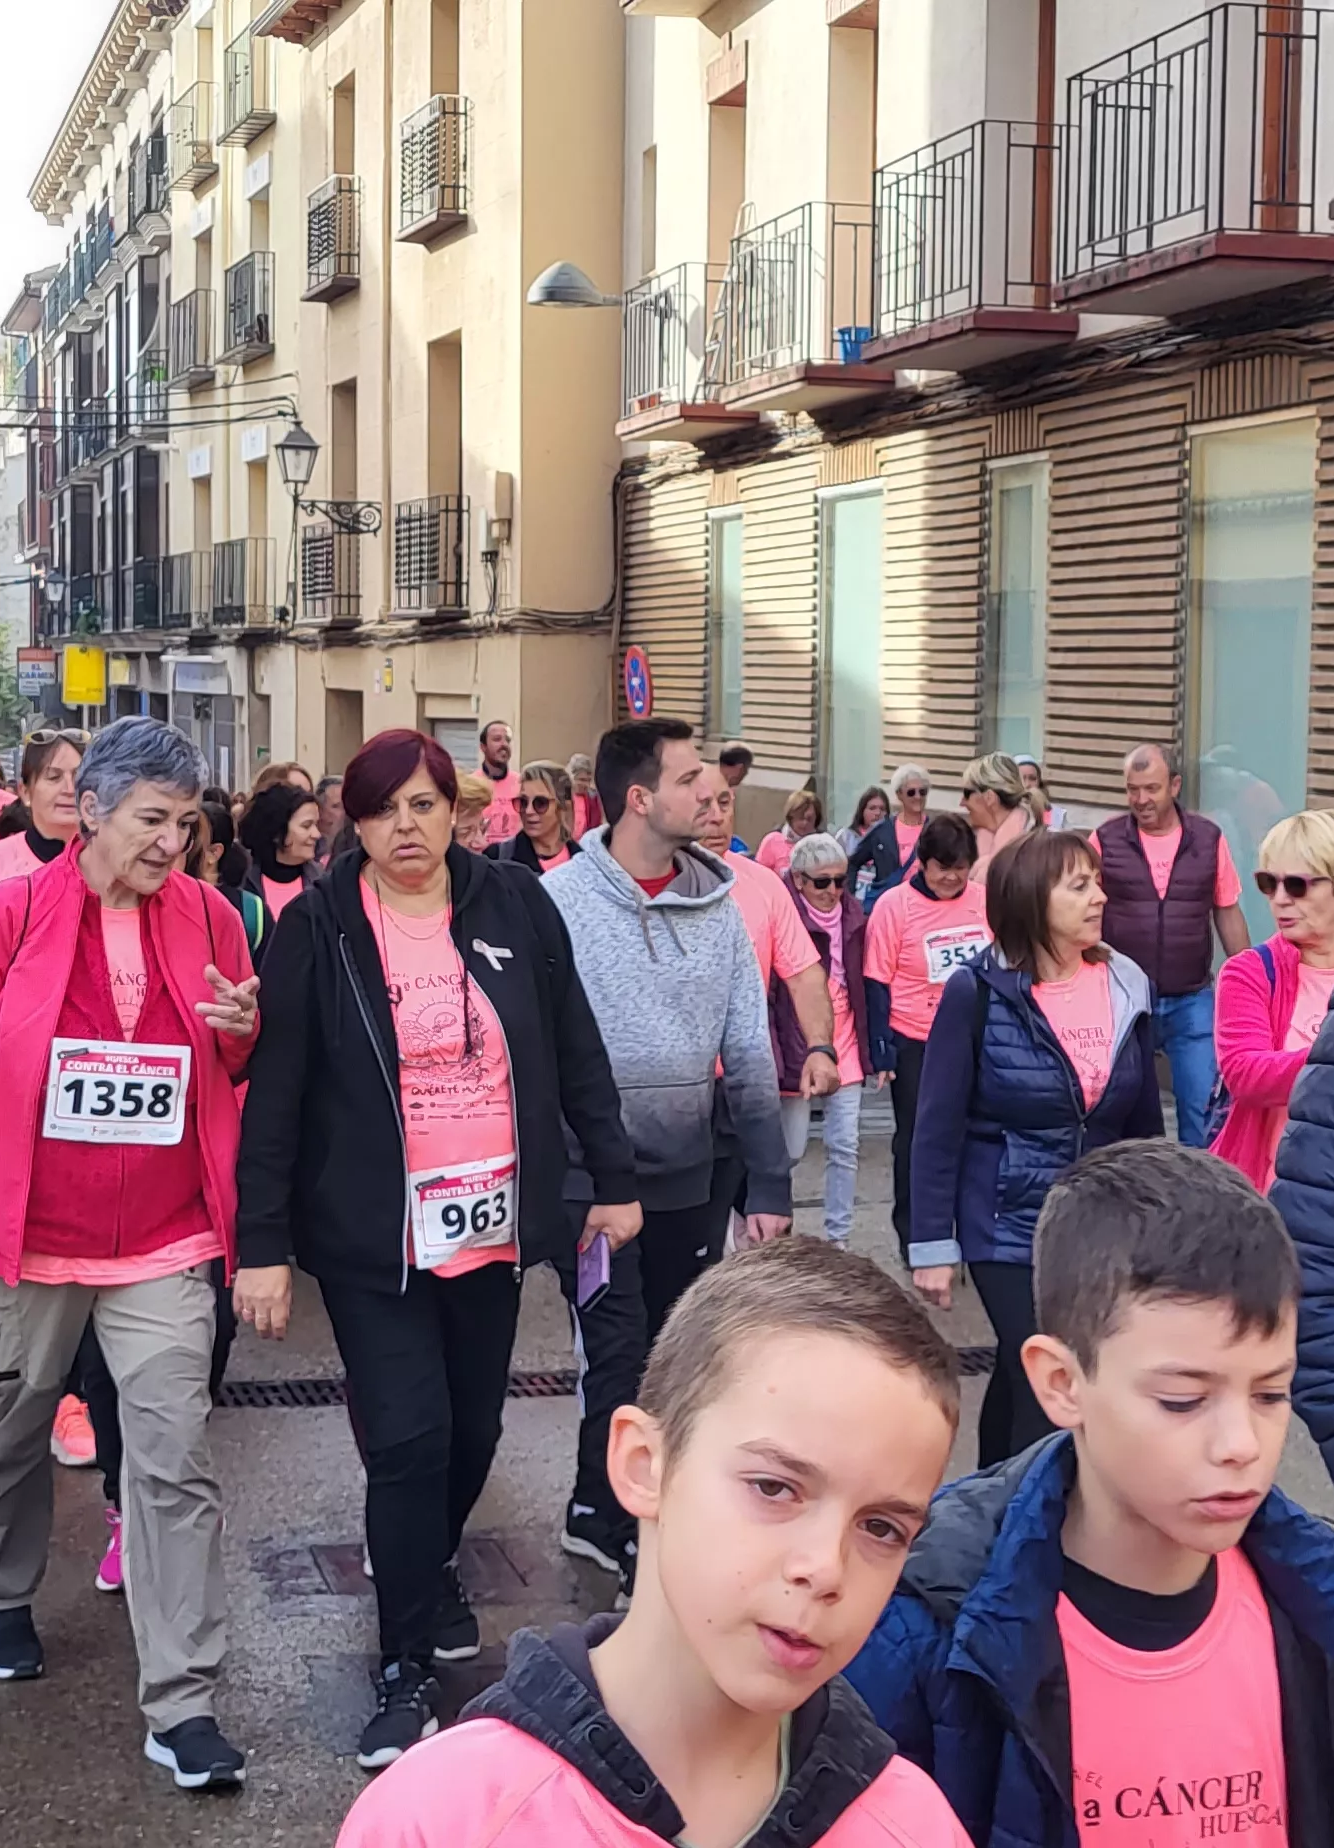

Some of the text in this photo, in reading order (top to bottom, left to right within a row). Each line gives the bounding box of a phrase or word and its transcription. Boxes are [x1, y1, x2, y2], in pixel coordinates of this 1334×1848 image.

[940, 944, 977, 967] 351
[65, 1060, 176, 1077] CONTRA EL CÁNCER
[104, 1055, 140, 1064] HUESCA
[64, 1078, 173, 1118] 1358
[424, 1184, 473, 1199] CONTRA
[473, 1181, 486, 1192] EL
[440, 1191, 507, 1240] 963
[1114, 1769, 1263, 1820] CÁNCER
[1199, 1803, 1284, 1839] HUESCA
